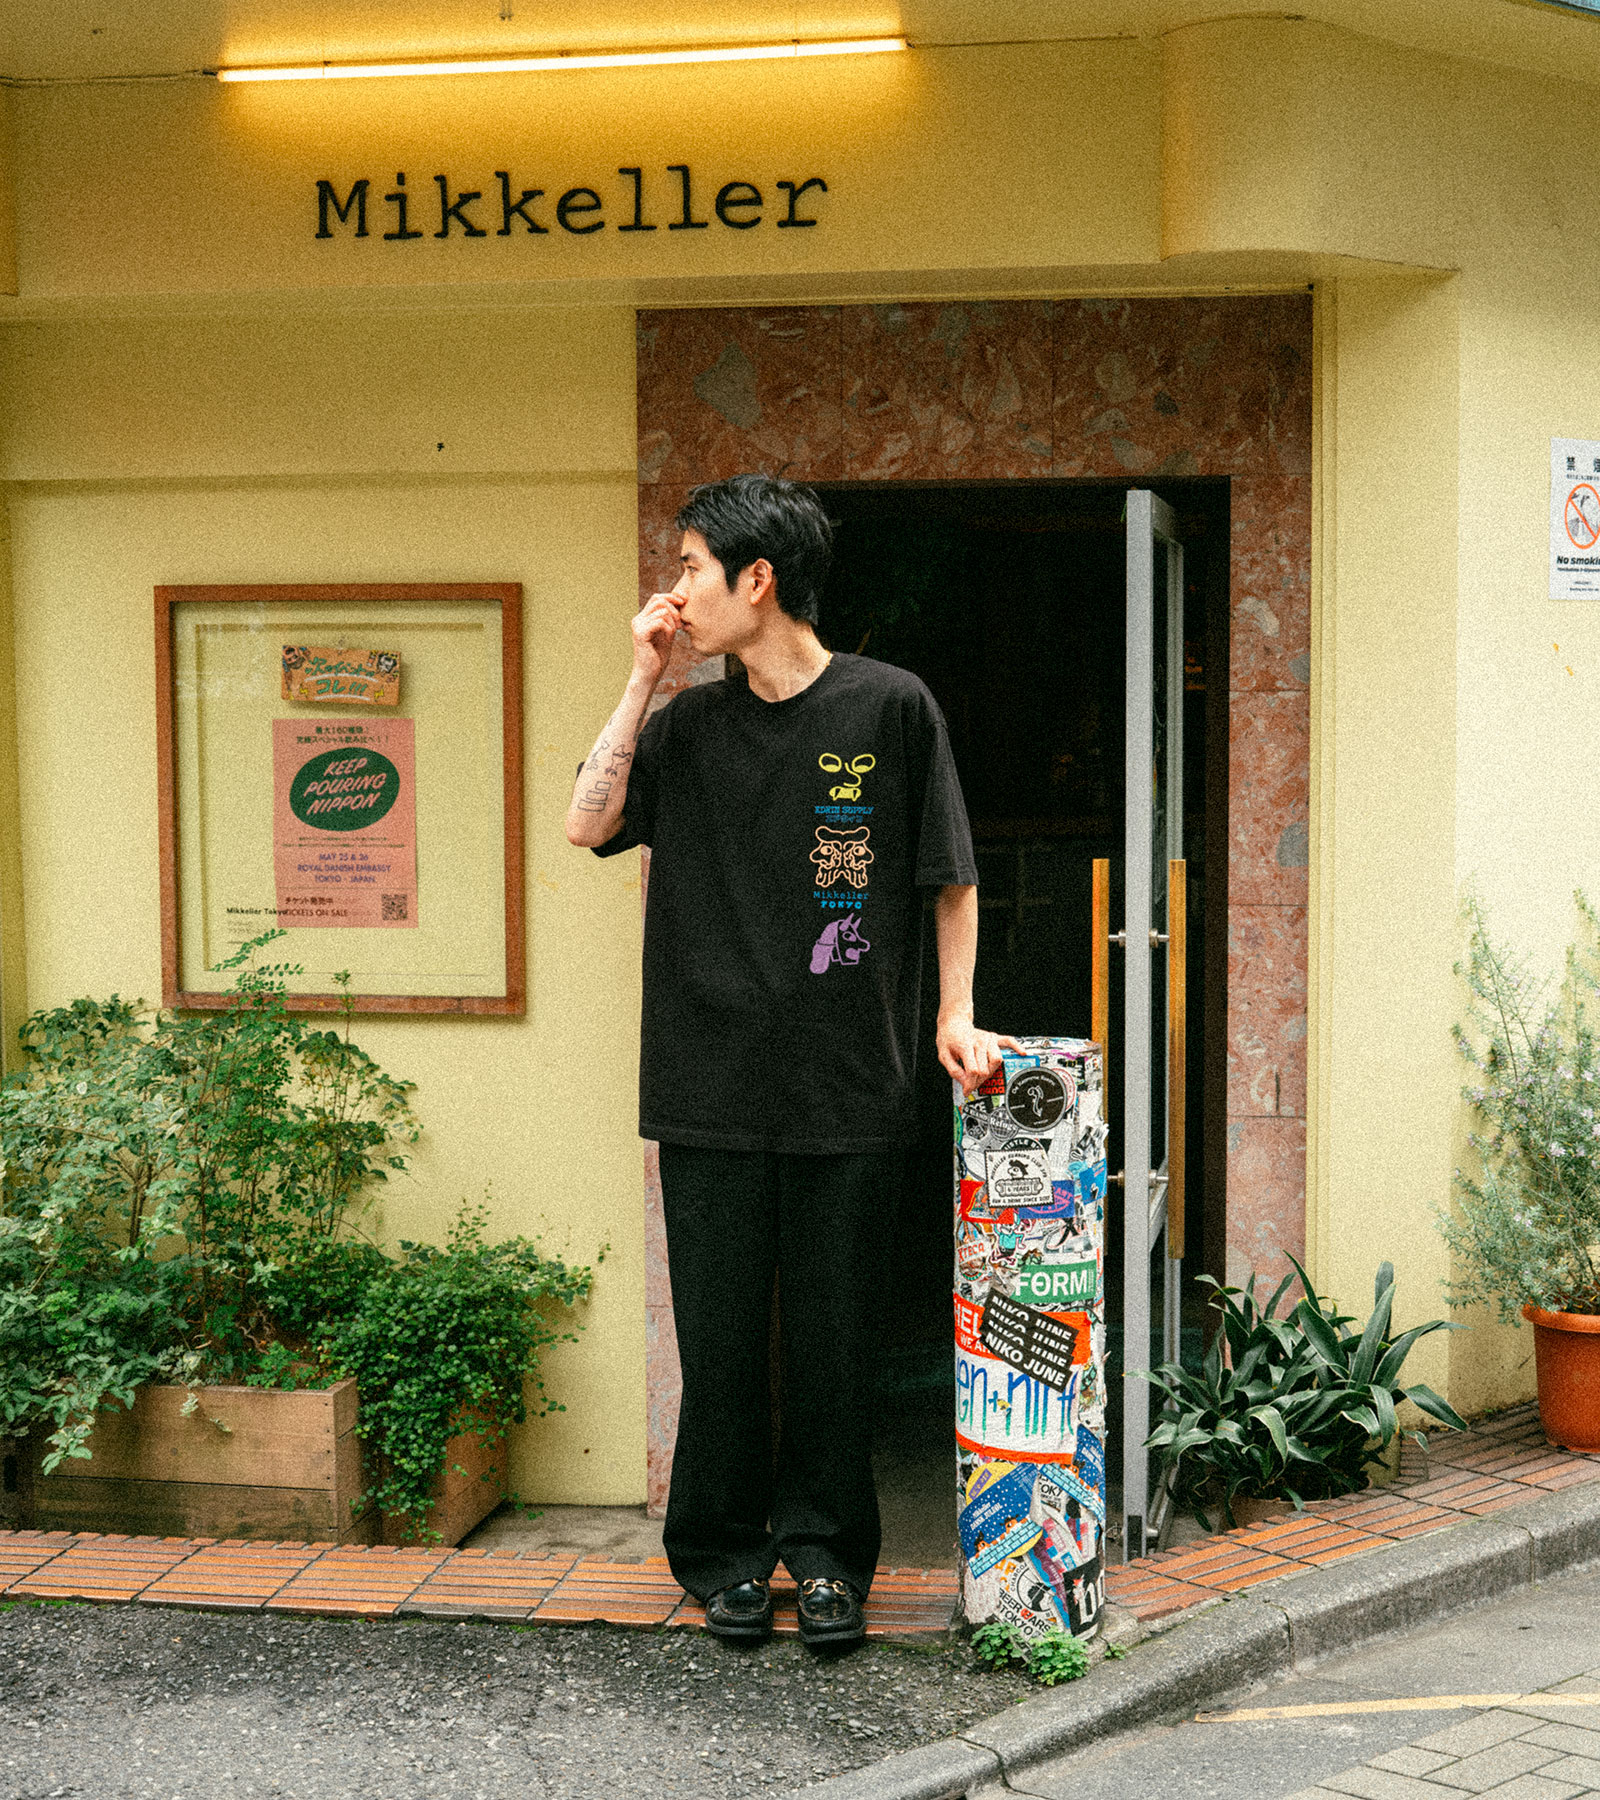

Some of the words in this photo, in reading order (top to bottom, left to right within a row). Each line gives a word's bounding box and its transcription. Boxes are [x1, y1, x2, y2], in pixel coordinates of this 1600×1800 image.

[315, 165, 828, 240] Mikkeller
[1556, 555, 1569, 565] No
[323, 757, 368, 776] KEEP
[303, 773, 387, 798] POURING
[306, 792, 381, 815] NIPPON
[841, 806, 874, 814] SUPPLY
[319, 853, 337, 861] MAY
[339, 853, 349, 861] 25
[350, 853, 357, 861] &
[297, 864, 323, 872] ROYAL
[324, 864, 354, 872] DANISH
[356, 864, 391, 872] EMBASSY
[315, 875, 342, 883] TOKYO
[349, 875, 376, 883] JAPAN
[813, 890, 869, 900] Mikkeller
[820, 900, 863, 909] TOKYO
[226, 907, 262, 915] Mikkeller
[315, 909, 329, 917] ON
[330, 909, 349, 917] SALE
[984, 1078, 1005, 1086] ana
[979, 1086, 1005, 1096] nana
[960, 1332, 973, 1347] WE
[985, 1332, 1023, 1363] NIKO
[1023, 1358, 1066, 1387] JUNE
[999, 1603, 1034, 1636] TOKYO
